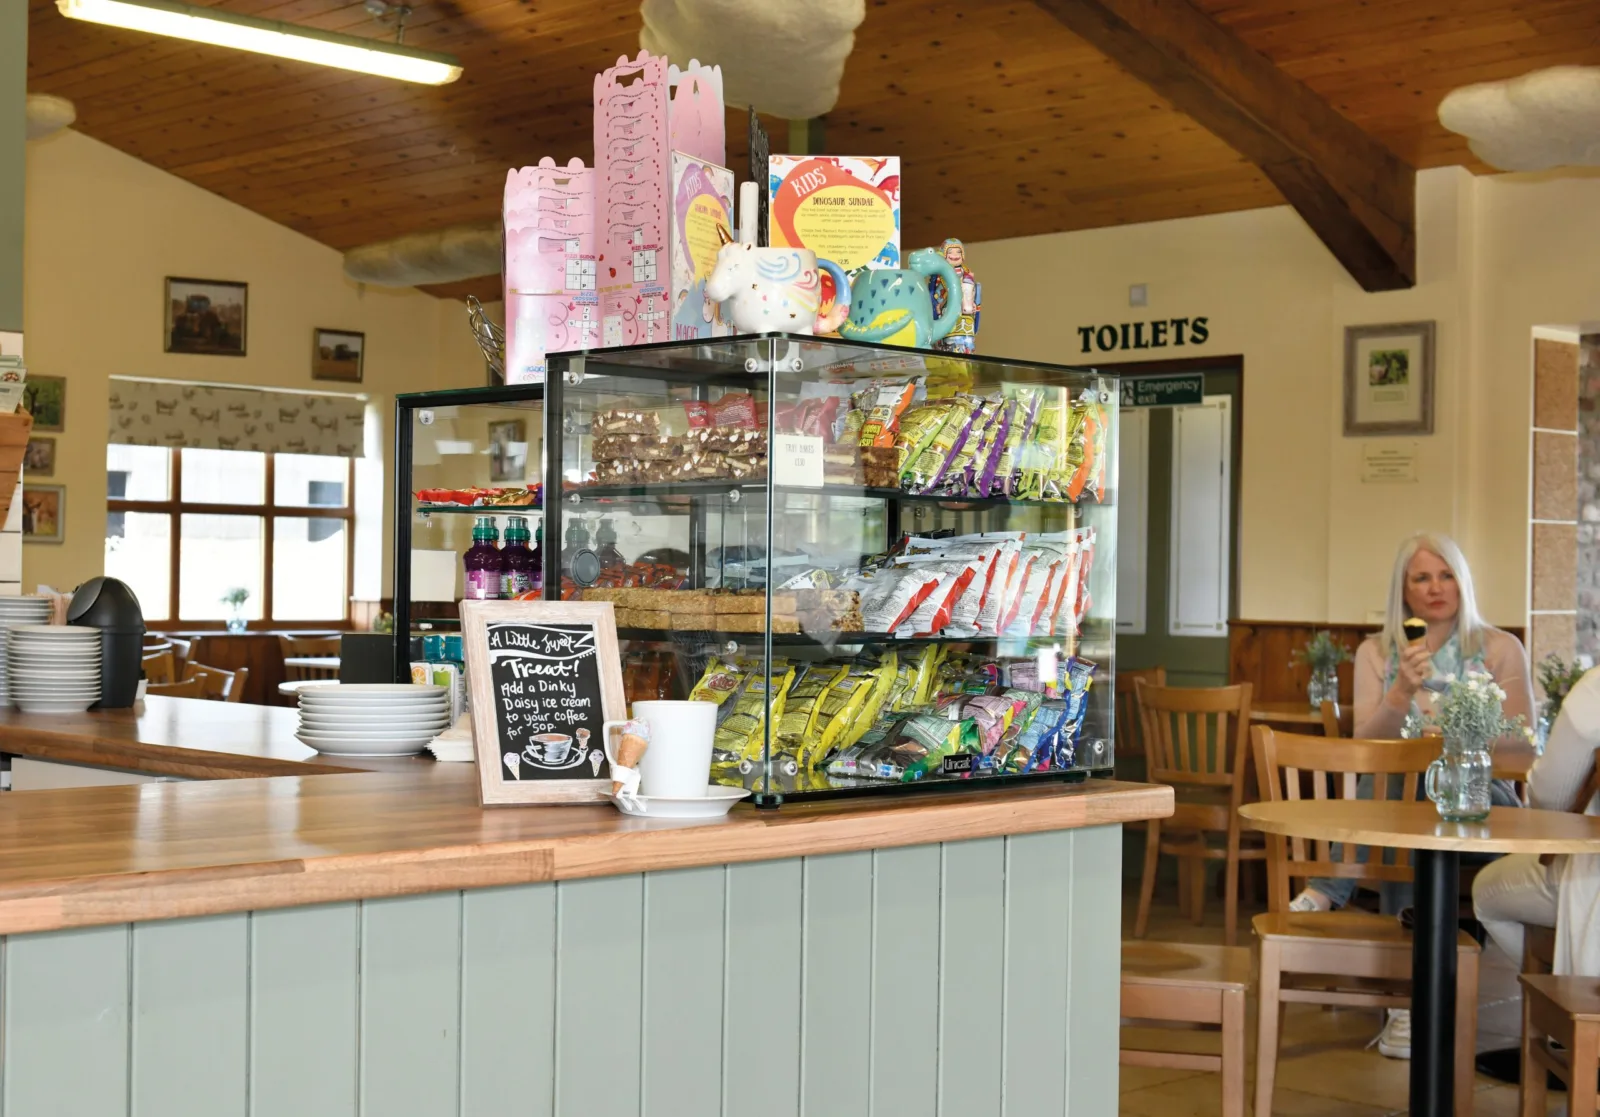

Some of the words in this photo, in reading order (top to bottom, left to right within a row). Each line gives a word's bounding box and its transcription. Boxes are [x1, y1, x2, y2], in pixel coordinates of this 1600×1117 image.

[790, 166, 827, 197] KIDS'
[812, 197, 846, 206] DINOSAUR
[848, 197, 874, 206] SUNDAE
[1077, 316, 1209, 353] TOILETS
[1137, 379, 1200, 394] Emergency
[1137, 394, 1157, 405] exit
[490, 631, 502, 648] A
[505, 631, 540, 649] Little
[501, 658, 580, 679] Treat!
[501, 681, 524, 697] Add
[528, 684, 536, 693] a
[538, 680, 577, 698] Dinky
[503, 698, 539, 714] Daisy
[542, 698, 558, 708] ice
[561, 698, 591, 707] cream
[506, 713, 519, 723] to
[524, 712, 550, 726] your
[554, 709, 588, 725] coffee
[506, 725, 523, 741] for
[944, 757, 971, 770] Lincat
